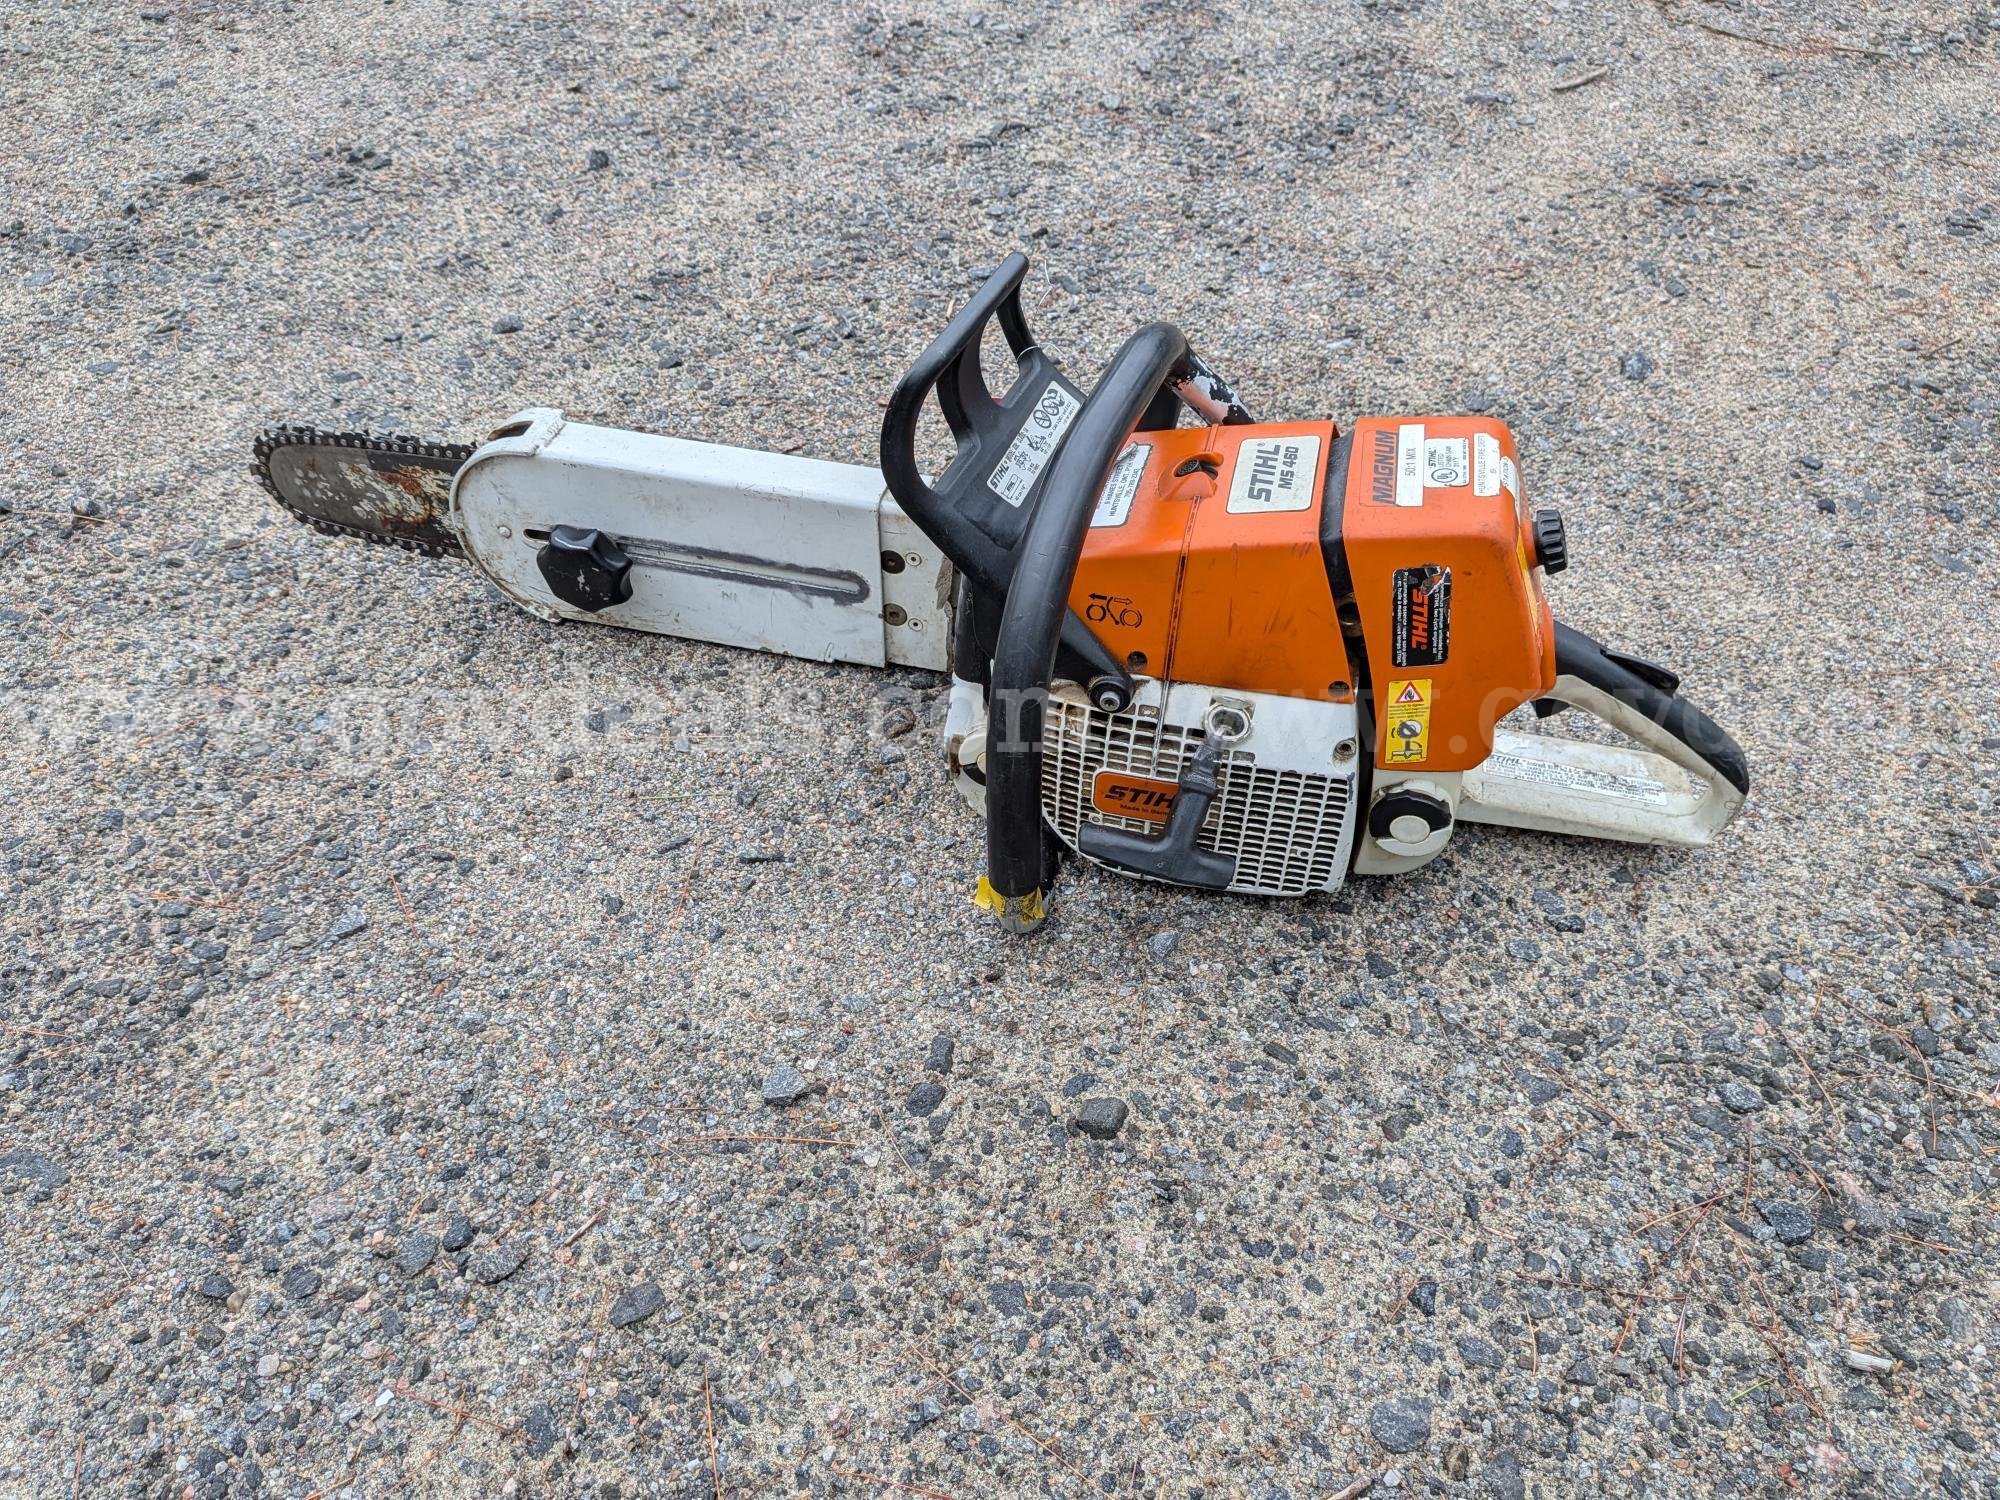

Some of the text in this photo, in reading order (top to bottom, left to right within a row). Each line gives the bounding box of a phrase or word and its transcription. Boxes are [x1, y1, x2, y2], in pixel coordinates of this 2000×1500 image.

[1247, 445, 1281, 502] STIHL
[1278, 446, 1299, 489] MS 460
[1372, 430, 1397, 503] MAGNUM
[1405, 448, 1416, 477] 50:1 MIX
[1428, 449, 1436, 467] STIHL
[990, 462, 1010, 490] STIHL
[1478, 461, 1486, 494] HUNTSVILLE
[1411, 589, 1428, 649] STIHL
[1104, 785, 1175, 808] STIH
